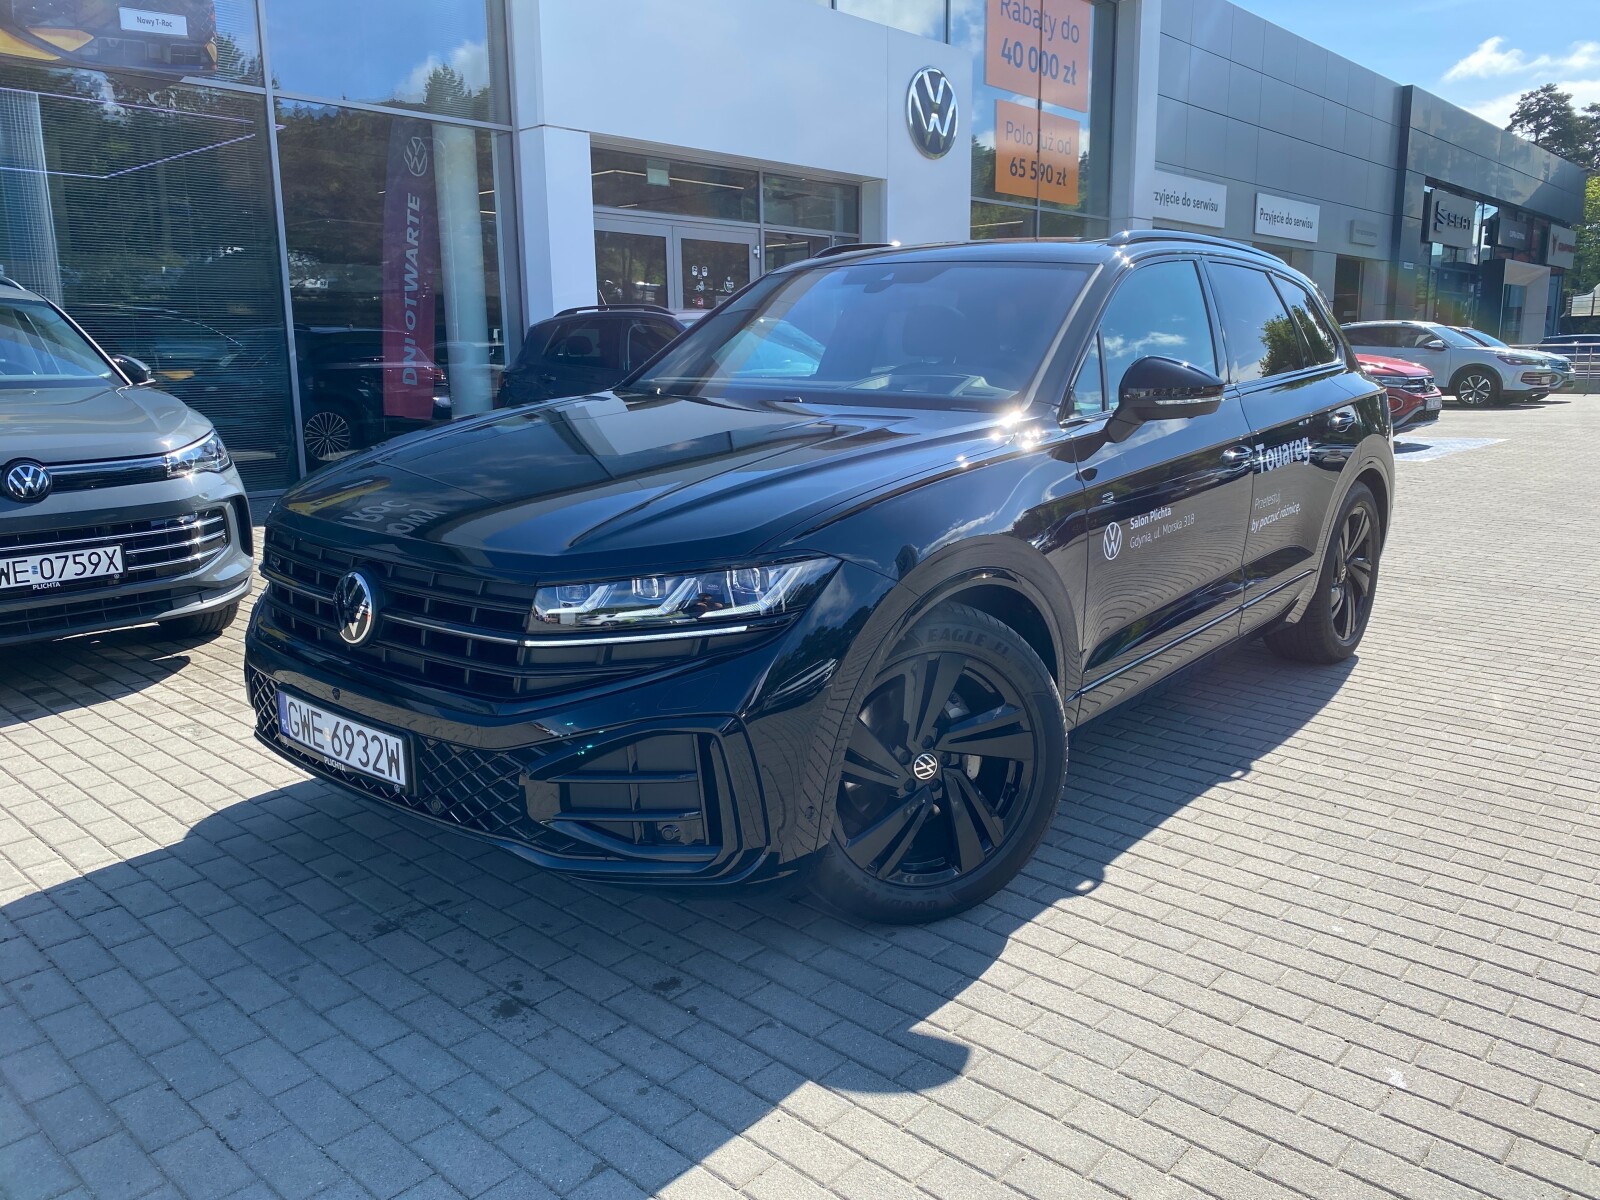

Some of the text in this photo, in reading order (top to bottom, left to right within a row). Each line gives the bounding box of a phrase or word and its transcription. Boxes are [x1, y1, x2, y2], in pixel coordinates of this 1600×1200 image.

[136, 16, 173, 28] Nowy T-Roc
[1000, 0, 1079, 43] Rabaty do
[1001, 37, 1077, 86] 40 000 zł
[1006, 121, 1034, 146] Polo
[1057, 137, 1072, 155] od
[1010, 157, 1067, 187] 65 590 zł
[1181, 191, 1191, 207] do
[1192, 197, 1219, 213] serwisu
[1260, 207, 1314, 230] Przyjęcie do serwisu
[402, 192, 421, 386] DNI OTWARTE
[1255, 436, 1310, 474] Touareg
[1130, 506, 1172, 530] Salon Plichta
[1162, 519, 1183, 536] Morska
[1183, 513, 1195, 528] 318
[39, 549, 119, 580] 0759X
[32, 581, 61, 591] PLICHTA
[927, 628, 987, 648] EAGLE
[288, 701, 401, 781] GWE 6932W
[324, 755, 346, 772] PLICHTA
